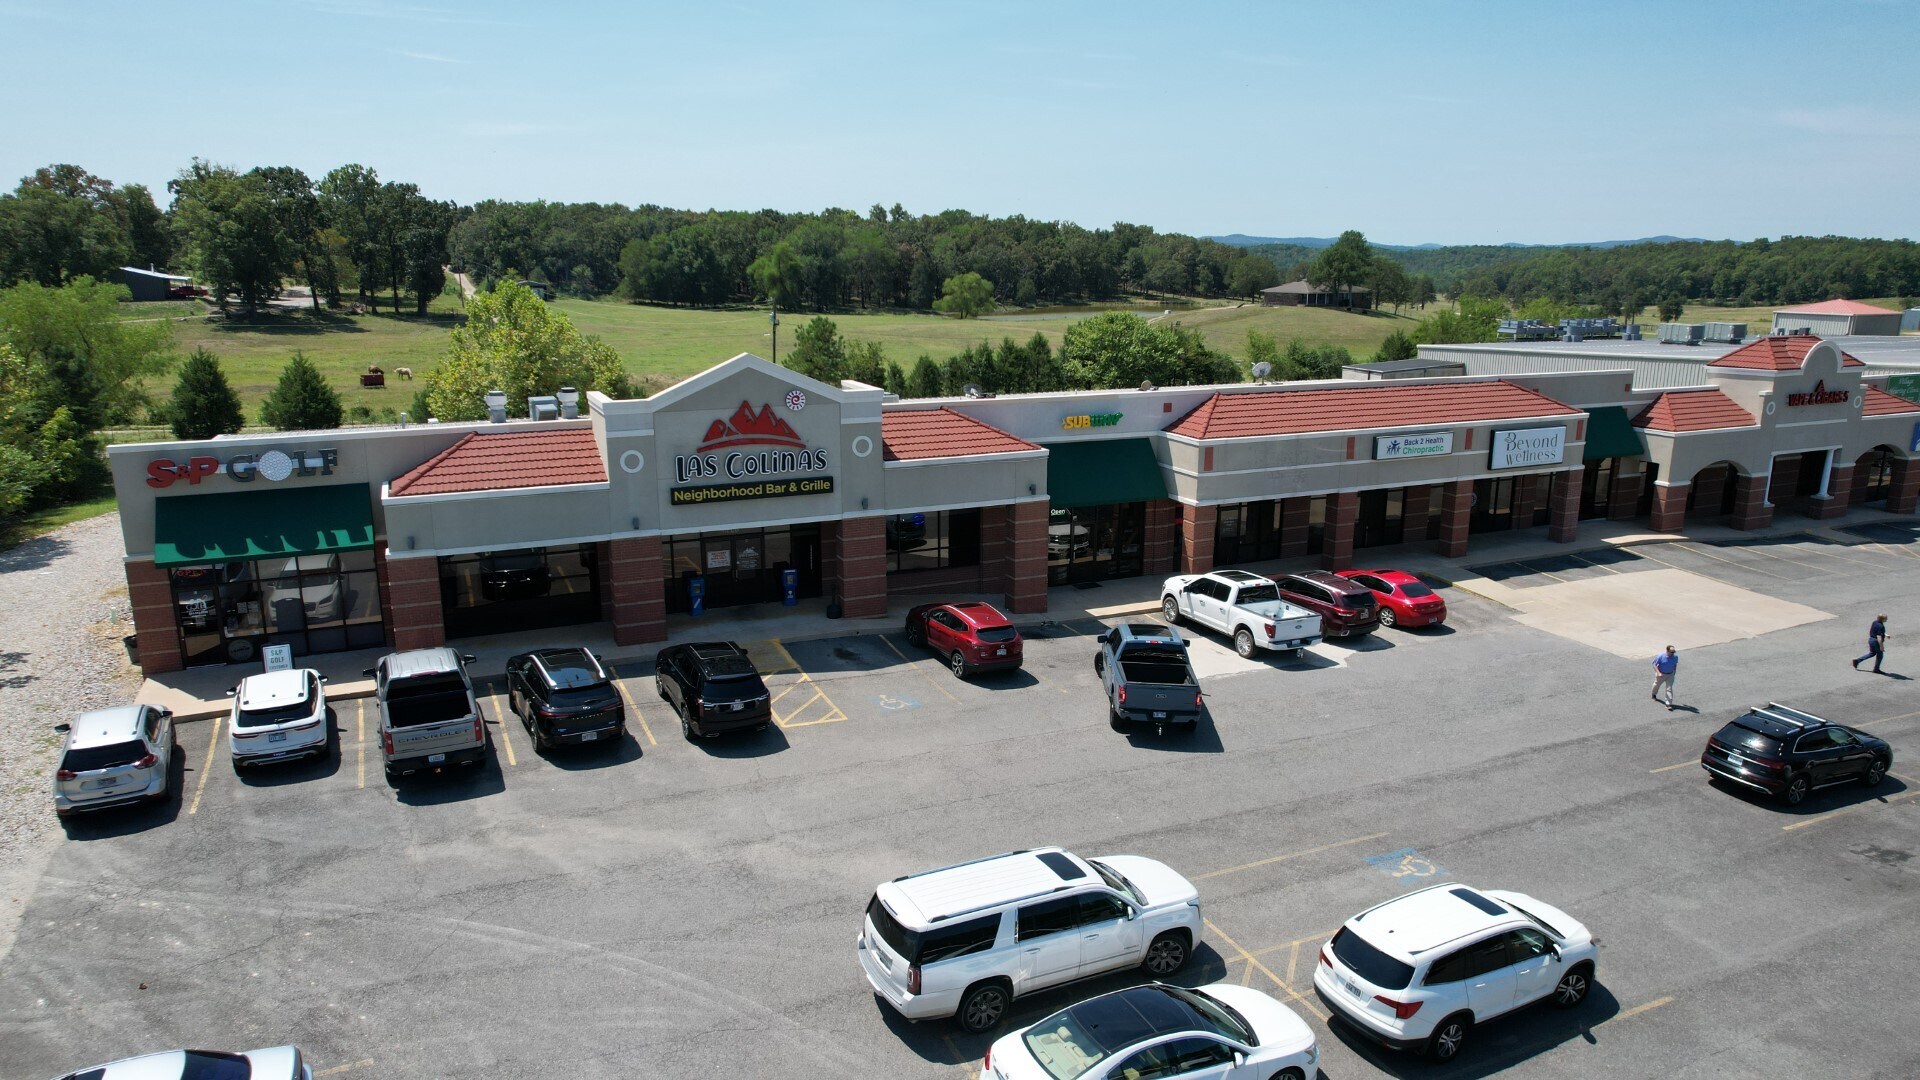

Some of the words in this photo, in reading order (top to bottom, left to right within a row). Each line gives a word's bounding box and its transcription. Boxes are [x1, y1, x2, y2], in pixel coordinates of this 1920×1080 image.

[1063, 412, 1123, 429] SUBWAY
[1403, 438, 1419, 446] Back
[1424, 436, 1444, 445] Health
[1504, 432, 1558, 451] Beyond
[1402, 445, 1445, 455] Chiropractic
[146, 456, 219, 489] S&P
[226, 448, 337, 482] GOLF
[673, 486, 763, 502] Neighborhood
[766, 483, 787, 493] Bar
[789, 481, 798, 492] &
[800, 479, 831, 491] Grille
[1050, 508, 1066, 516] Open
[398, 729, 468, 742] CHEVROLET
